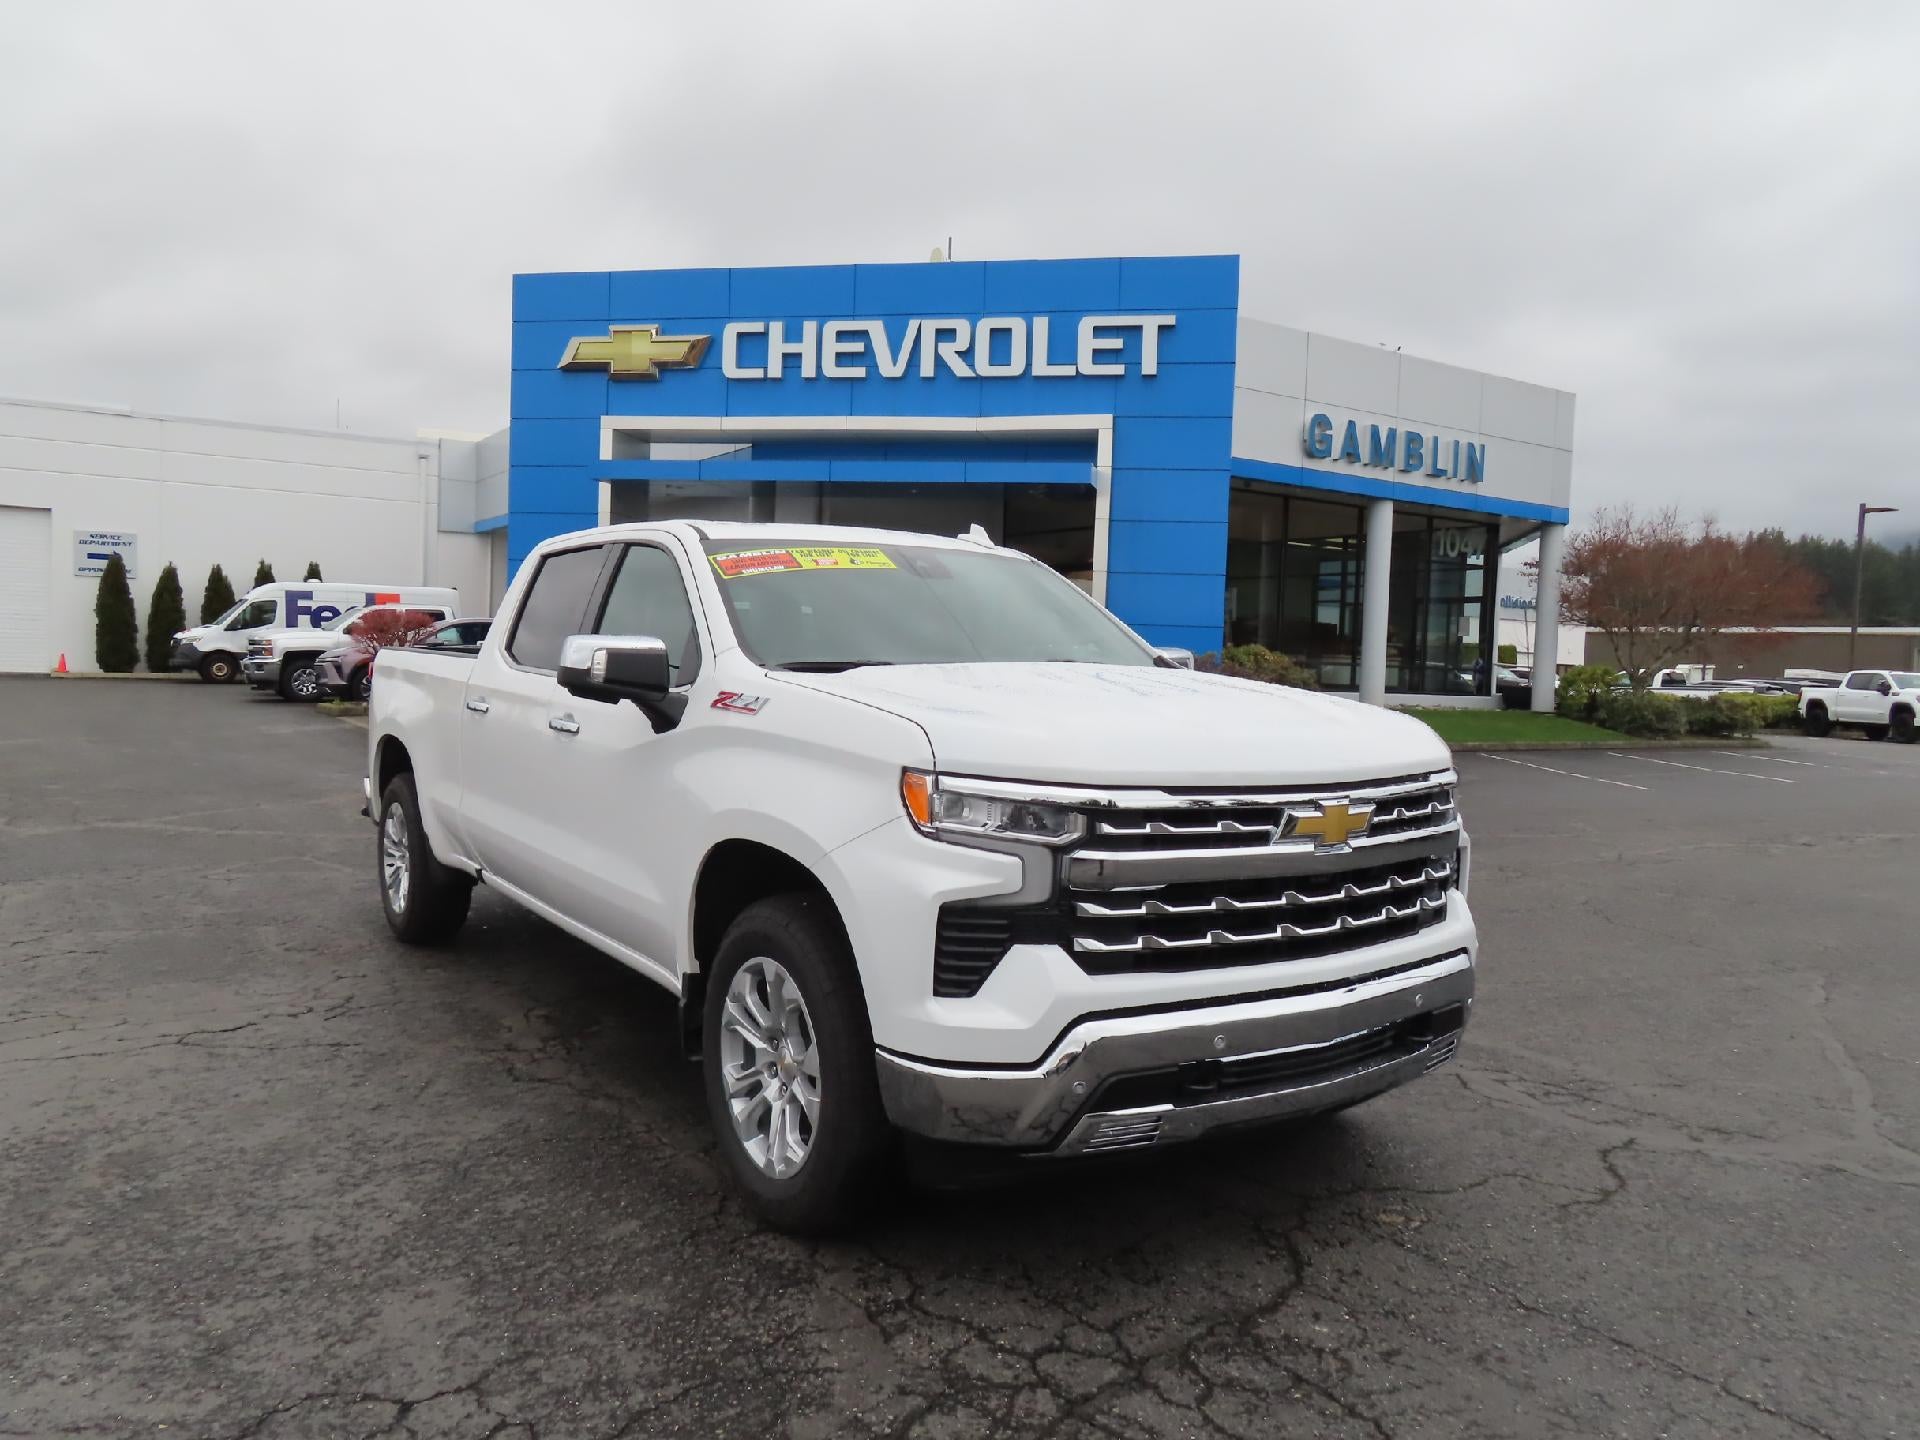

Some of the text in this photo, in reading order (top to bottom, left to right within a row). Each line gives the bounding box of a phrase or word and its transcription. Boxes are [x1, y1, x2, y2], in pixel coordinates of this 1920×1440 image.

[722, 314, 1176, 379] CHEVROLET
[1304, 413, 1486, 483] GAMBLIN
[78, 539, 132, 547] DEPARTMENT
[89, 533, 122, 541] SERVICE
